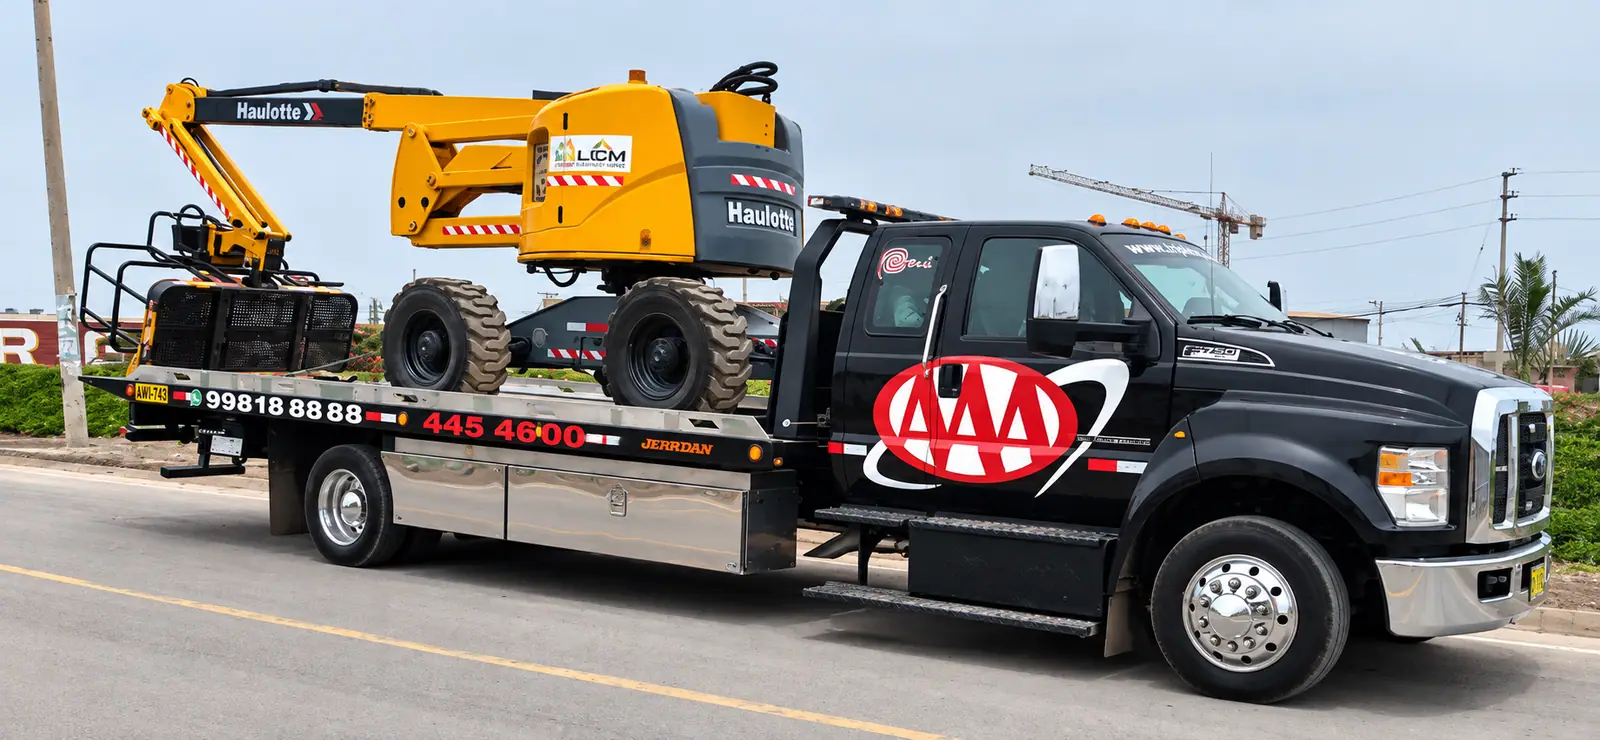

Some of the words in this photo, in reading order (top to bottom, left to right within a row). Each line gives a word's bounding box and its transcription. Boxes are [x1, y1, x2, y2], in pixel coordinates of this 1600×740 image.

[236, 102, 301, 120] Haulotte
[727, 201, 795, 233] Haulotte
[136, 385, 167, 402] AWI-743
[422, 411, 485, 438] 445
[494, 418, 586, 449] 4600
[889, 361, 1060, 478] AAA
[640, 438, 714, 456] JERRDAN
